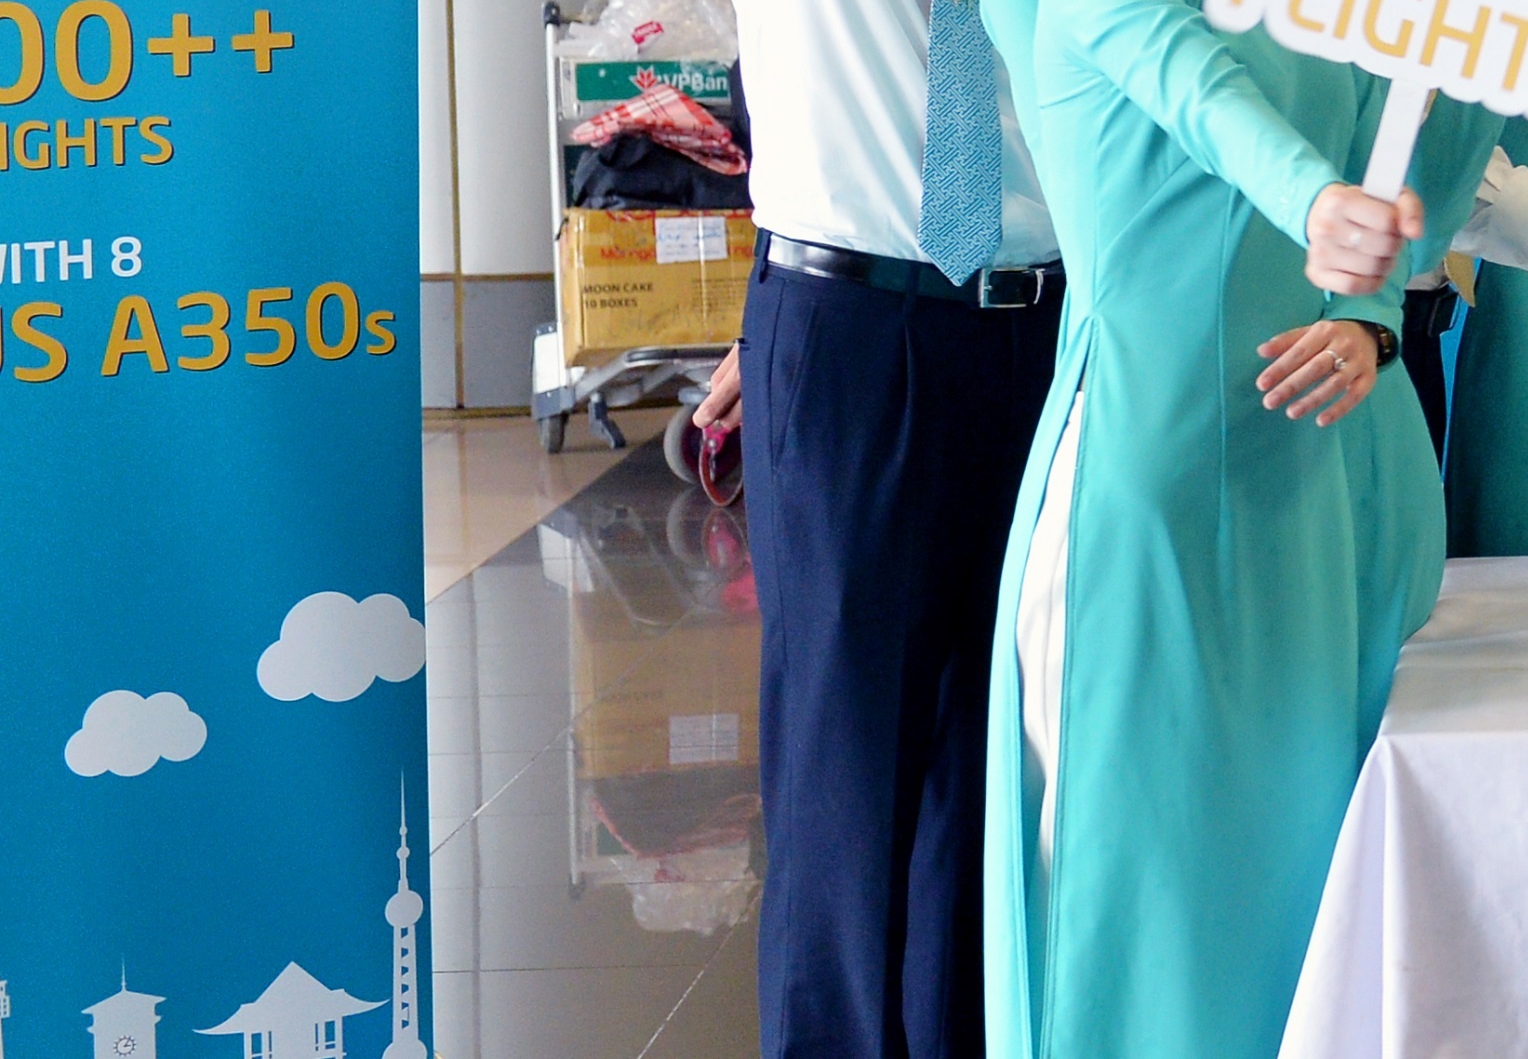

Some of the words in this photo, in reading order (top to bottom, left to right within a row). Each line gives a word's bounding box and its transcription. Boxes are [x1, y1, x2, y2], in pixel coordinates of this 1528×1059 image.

[0, 238, 93, 285] ITH
[110, 236, 142, 278] 8
[584, 283, 621, 294] MOON
[623, 282, 654, 292] CAKE
[600, 298, 638, 309] BOXES
[0, 301, 68, 383] S
[101, 281, 397, 377] A350s
